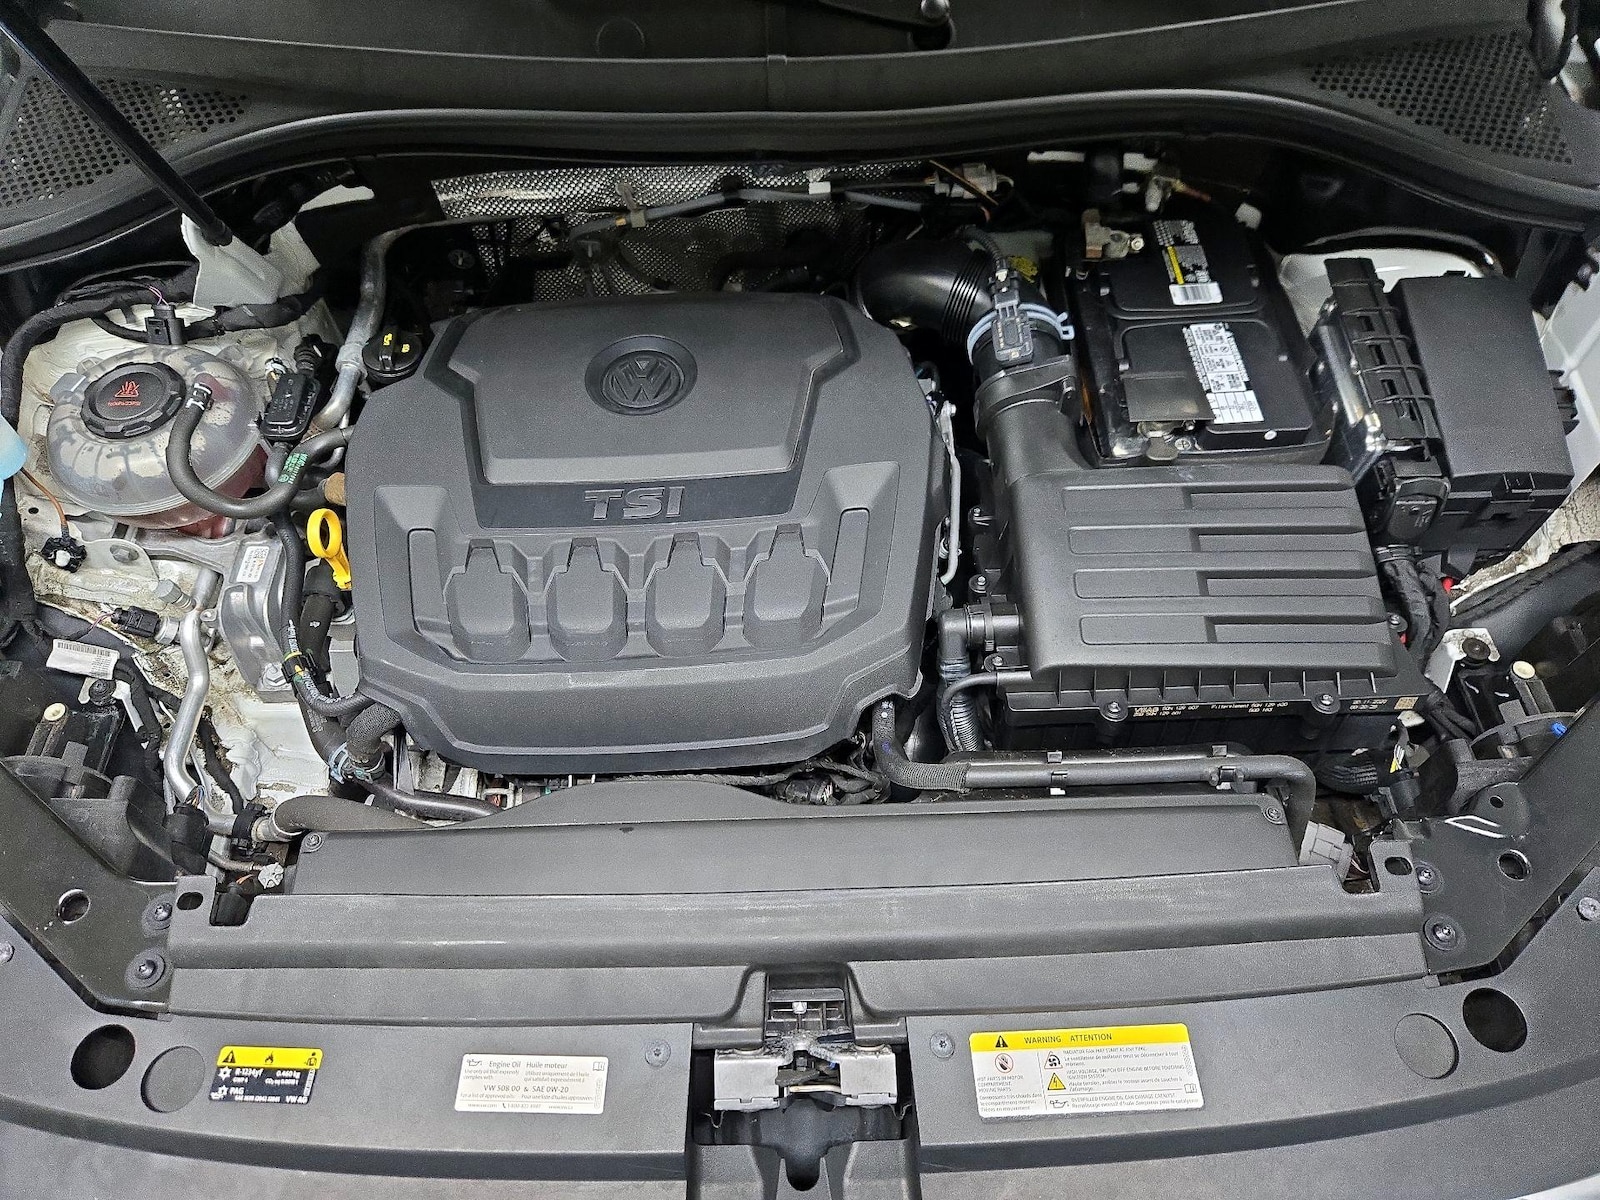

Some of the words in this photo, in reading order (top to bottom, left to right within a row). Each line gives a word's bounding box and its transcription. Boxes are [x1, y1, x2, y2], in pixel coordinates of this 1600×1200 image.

[602, 350, 686, 409] VW
[584, 486, 686, 521] TSI
[1023, 1035, 1062, 1044] WARNING
[1070, 1033, 1113, 1042] ATTENTION
[489, 1060, 511, 1070] Engine
[229, 1087, 244, 1095] PAG
[532, 1085, 545, 1093] SAE
[296, 1096, 308, 1104] AG
